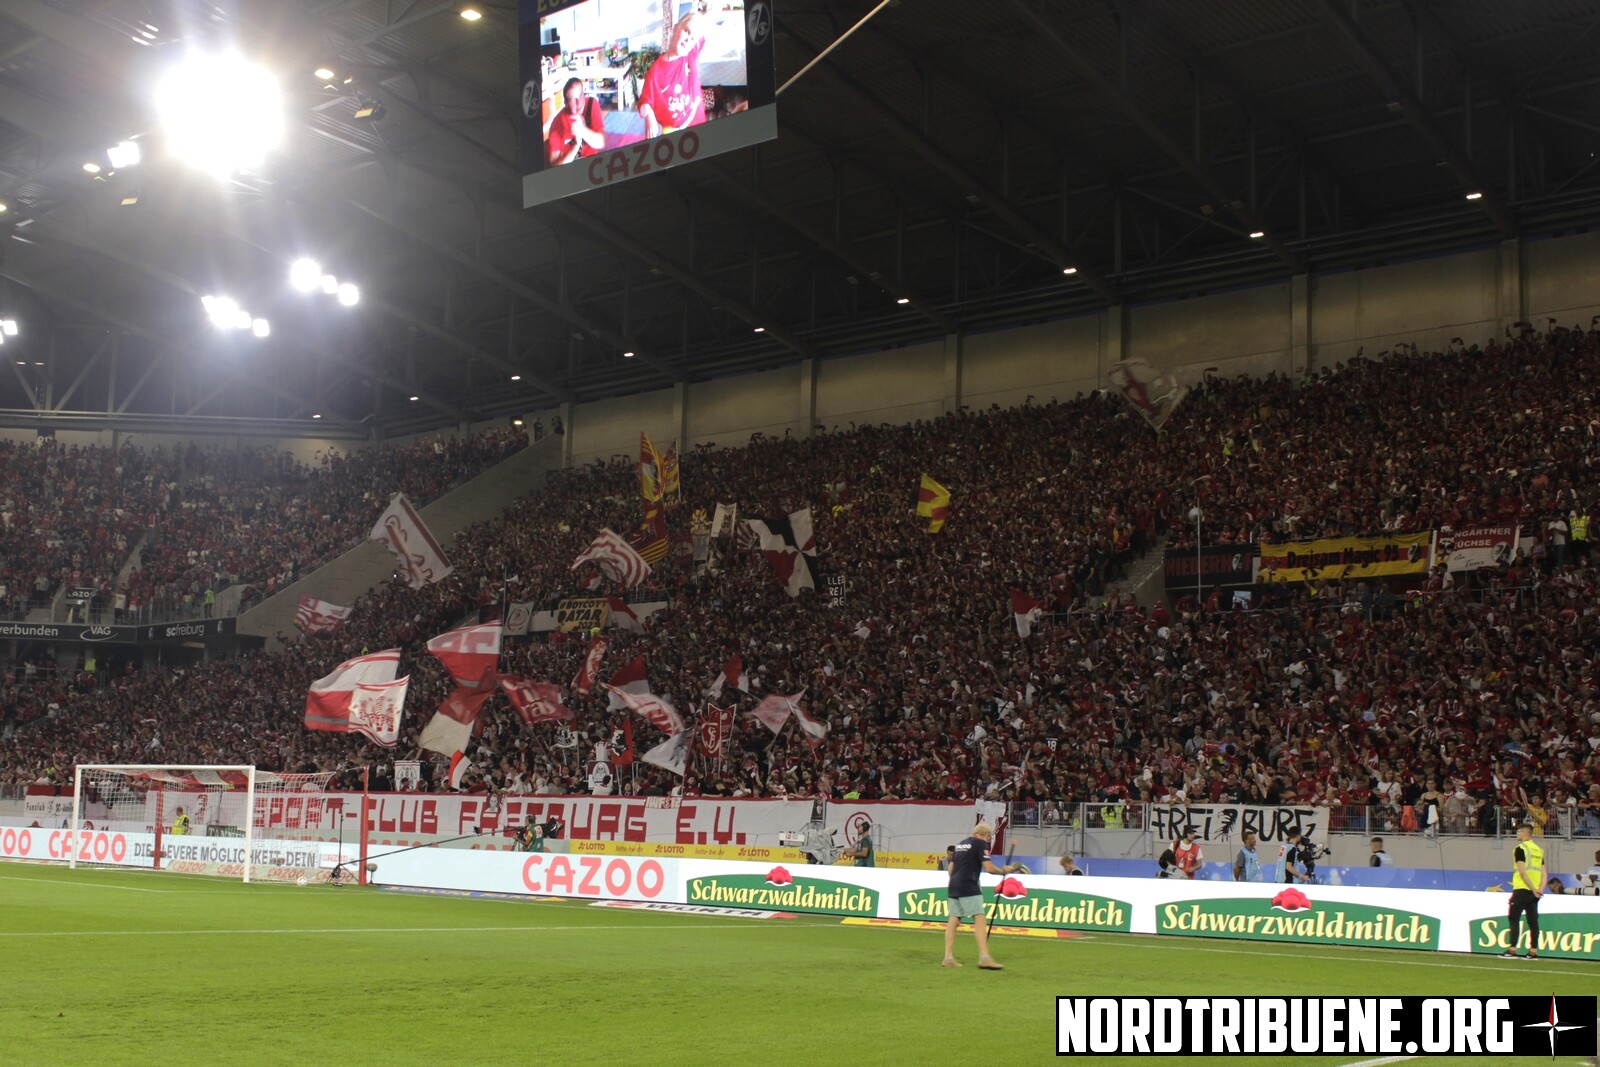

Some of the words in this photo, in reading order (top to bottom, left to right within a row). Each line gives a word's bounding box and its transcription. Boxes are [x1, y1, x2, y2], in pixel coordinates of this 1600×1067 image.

[588, 130, 700, 186] CAZOO
[1343, 545, 1380, 568] Magic
[1383, 544, 1399, 561] 95
[557, 609, 603, 624] QATAR
[559, 600, 609, 610] #BOYCOTT
[90, 625, 111, 636] VAG
[1047, 740, 1057, 752] 18
[26, 802, 45, 811] Fanclub
[252, 797, 438, 835] SPORT-CLUB
[1241, 807, 1317, 842] BURG
[134, 843, 152, 858] DIE
[285, 850, 315, 868] DEIN
[585, 843, 605, 852] LOTTO
[615, 845, 644, 853] lotto-bw.de
[663, 845, 685, 855] LOTTO
[695, 847, 725, 856] lotto-bw.de
[747, 849, 770, 858] LOTTO
[875, 855, 910, 864] lotto-bw.de
[521, 855, 665, 899] CAZOO
[691, 878, 872, 912] Schwarzwaldmilch
[904, 890, 1124, 927] Schzwaldmilch
[1162, 903, 1431, 943] Schwarzwaldmilch
